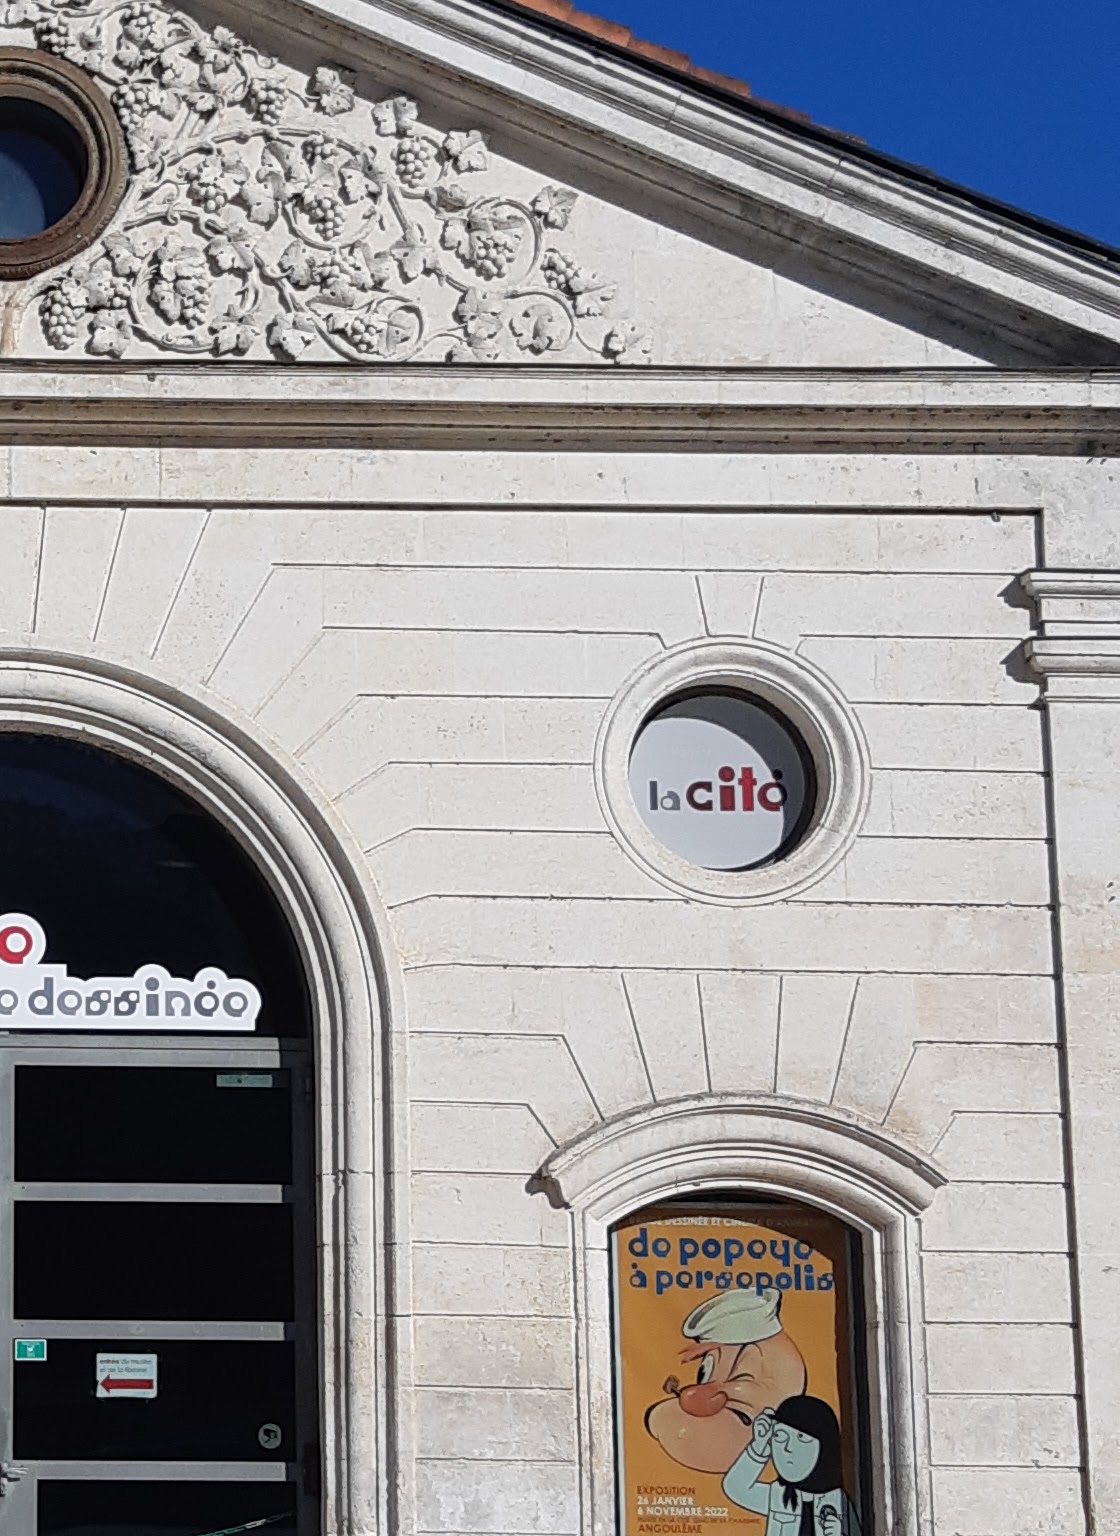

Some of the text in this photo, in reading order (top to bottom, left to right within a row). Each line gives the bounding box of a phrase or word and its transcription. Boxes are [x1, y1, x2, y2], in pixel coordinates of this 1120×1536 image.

[649, 780, 681, 811] la
[636, 1485, 696, 1496] EXPOSITION
[652, 1496, 694, 1506] JANVIER
[646, 1506, 702, 1517] NOVEMBRE
[704, 1507, 729, 1517] 2022
[637, 1522, 703, 1534] ANGOULÊME
